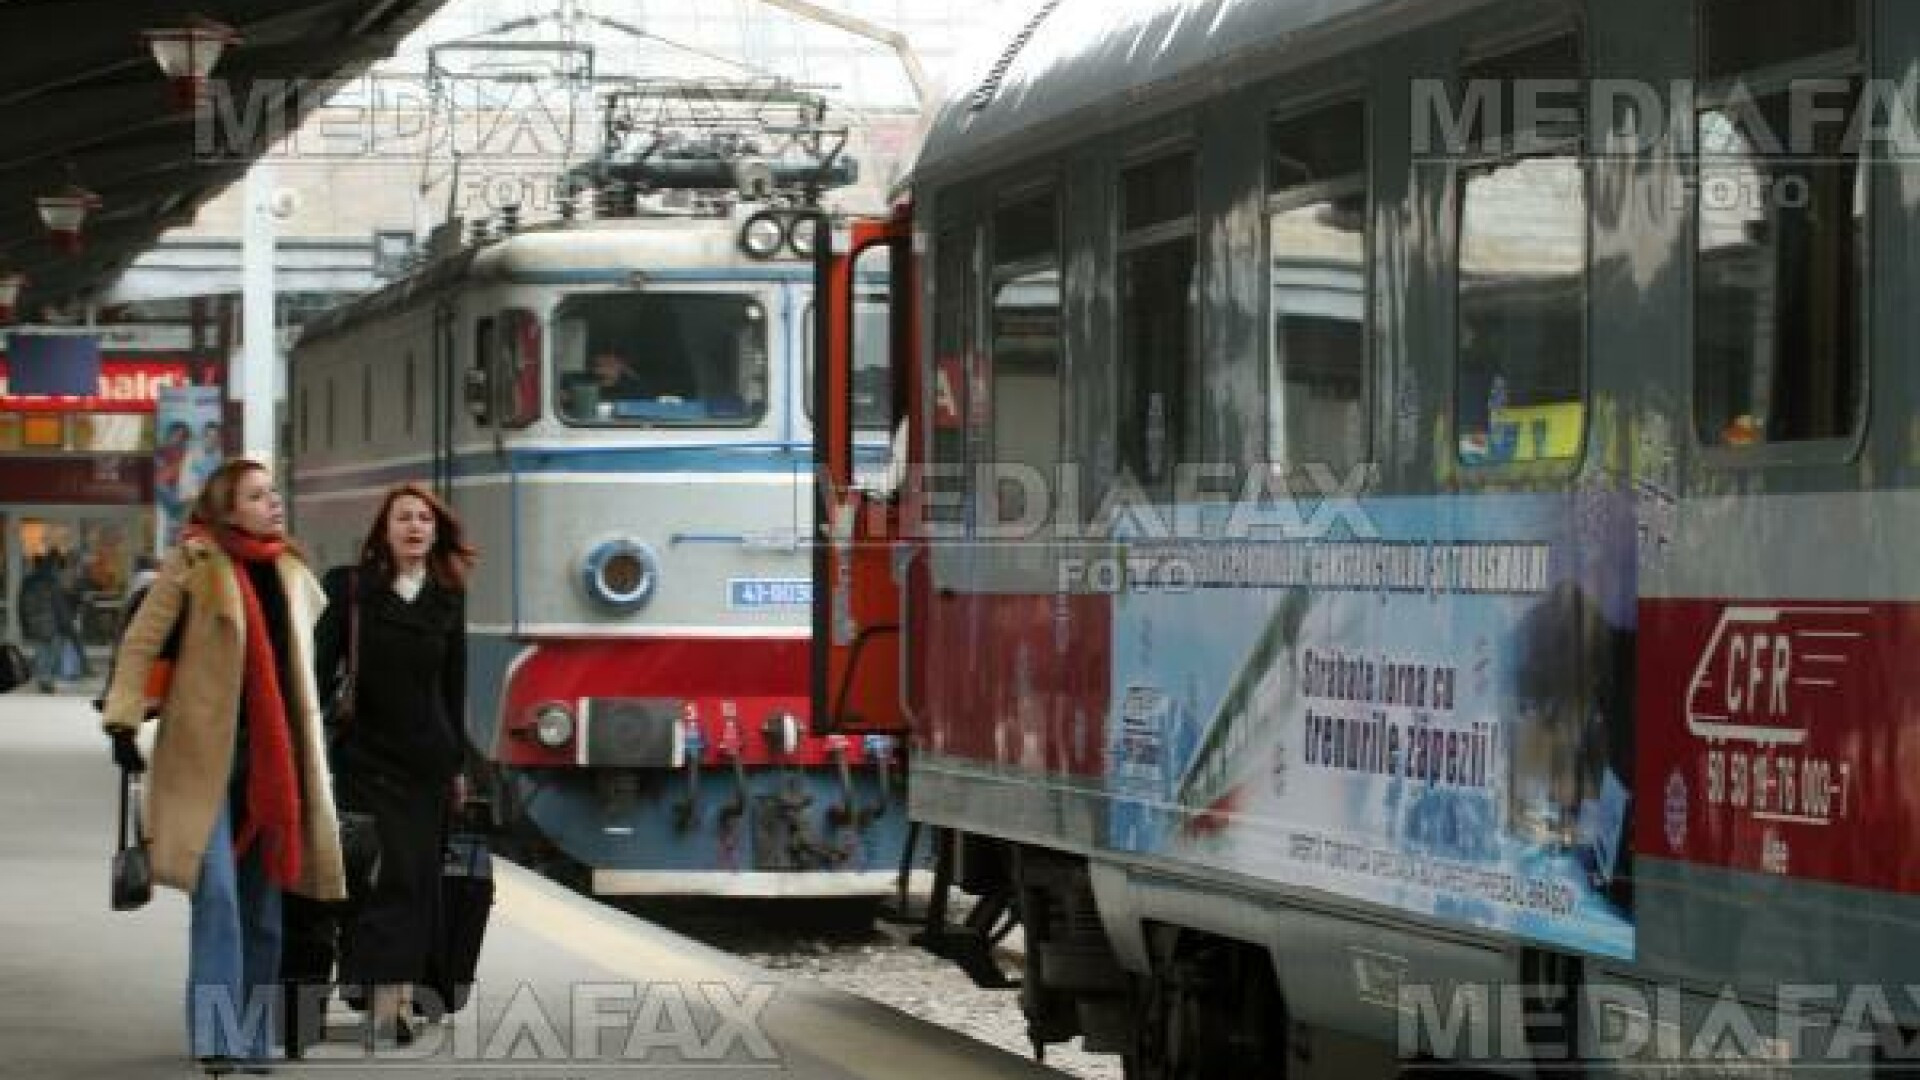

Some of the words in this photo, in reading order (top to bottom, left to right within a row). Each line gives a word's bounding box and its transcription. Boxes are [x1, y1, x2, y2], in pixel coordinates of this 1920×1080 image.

[1432, 666, 1455, 710] cu
[1726, 632, 1791, 716] CFR
[1304, 708, 1399, 775] trenurile
